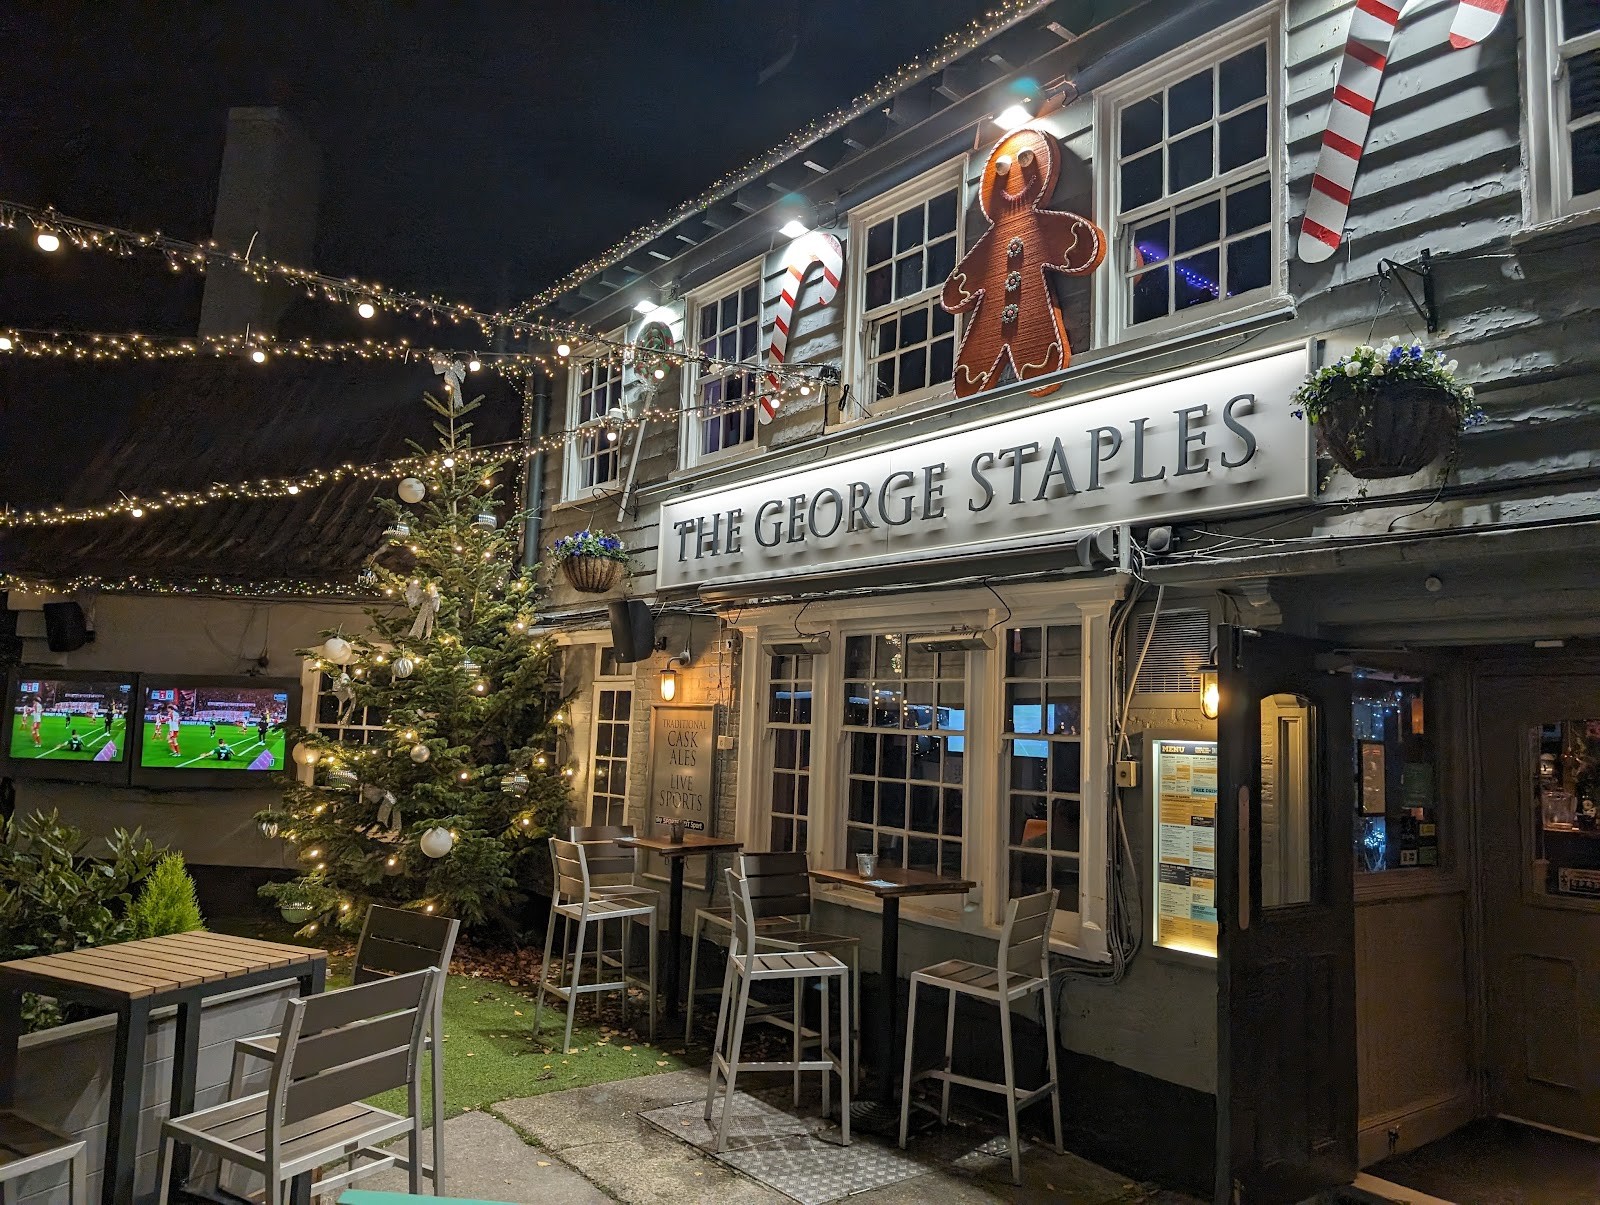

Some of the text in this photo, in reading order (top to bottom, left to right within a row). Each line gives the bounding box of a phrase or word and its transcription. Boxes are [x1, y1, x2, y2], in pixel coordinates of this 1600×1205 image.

[674, 393, 1255, 562] THE GEORGE STAPLES
[663, 719, 708, 729] TRADITIONAL
[668, 730, 698, 748] CASK
[670, 749, 697, 767] ALES
[670, 774, 693, 791] LIVE
[660, 790, 702, 812] SPORTS
[690, 821, 703, 830] Sport
